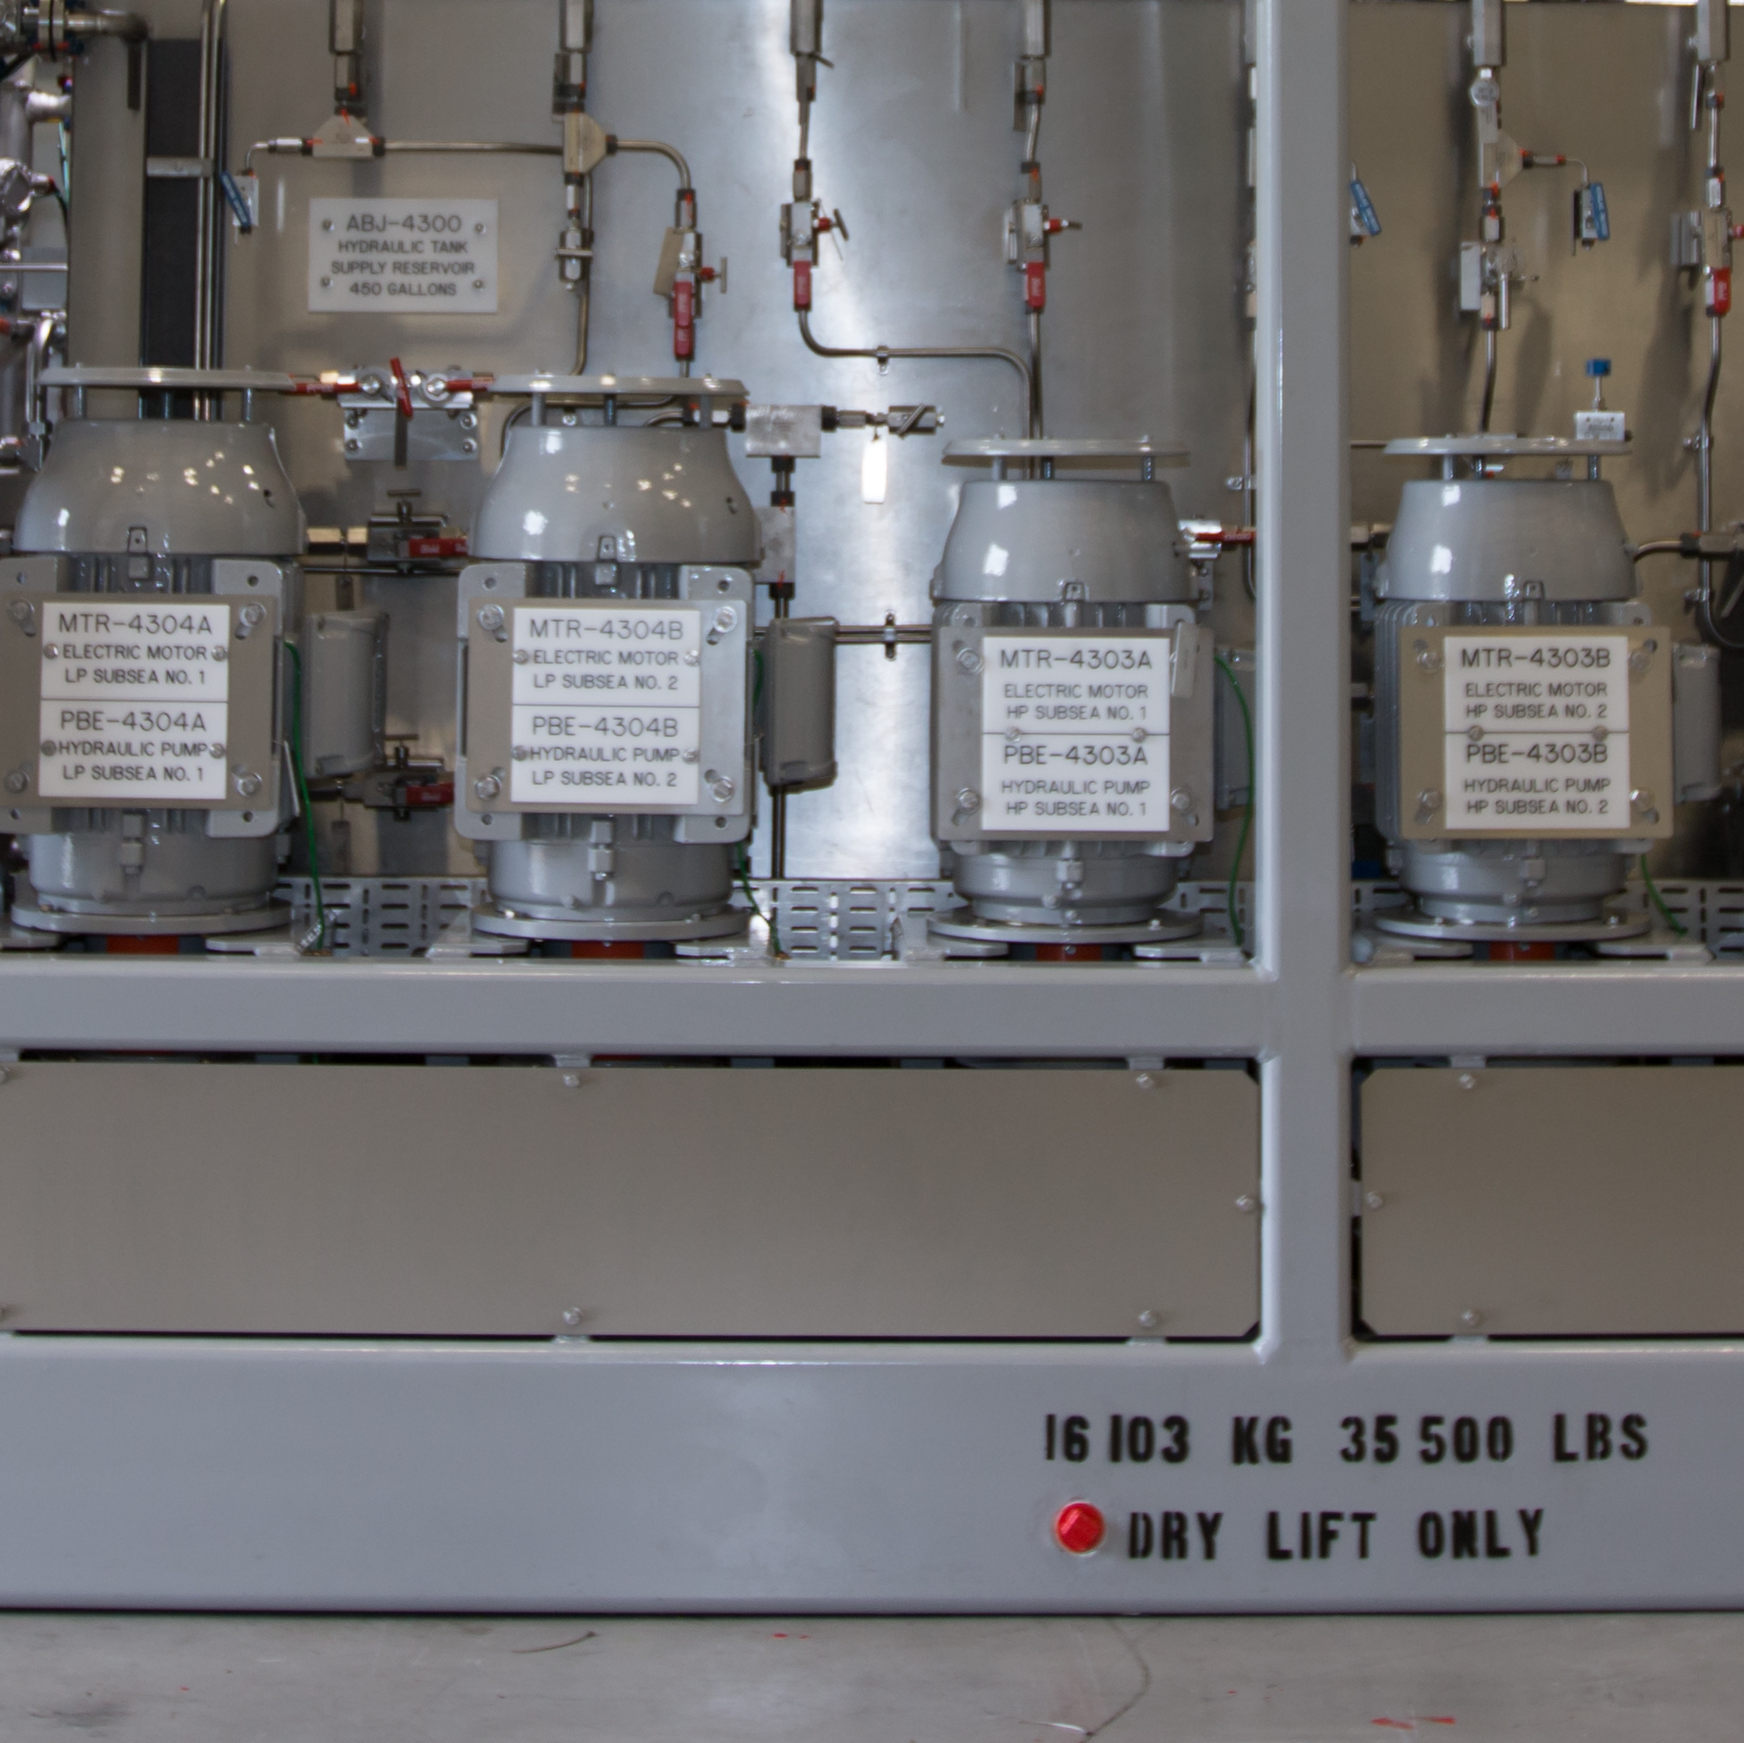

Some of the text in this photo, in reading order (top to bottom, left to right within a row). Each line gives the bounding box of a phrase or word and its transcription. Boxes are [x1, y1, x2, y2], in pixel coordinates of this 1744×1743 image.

[345, 213, 462, 234] ABJ-4300
[338, 239, 467, 254] HYDRAULIC TANK
[331, 260, 475, 275] SUPPLY RESERVOIR
[349, 281, 457, 296] 450 GALLONS
[58, 611, 212, 635] MTR-4304A
[529, 618, 684, 641] MTR-4304B
[62, 643, 207, 661] ELECTRIC MOTOR
[531, 649, 679, 666] ELECTRIC MOTOR
[1000, 648, 1152, 670] MTR-4303A
[1461, 647, 1611, 669] MTR-4303B
[64, 667, 205, 685] LP SUBSEA NO. 1
[533, 673, 678, 691] LP SUBSEA NO. 2
[1004, 683, 1148, 699] ELECTRIC MOTOR
[1465, 682, 1607, 698] ELECTRIC MOTOR
[1006, 704, 1147, 721] HP SUBSEA NO. 1
[1465, 703, 1608, 719] HP SUBSEA NO. 2
[59, 709, 206, 732] PBE-4304A
[532, 715, 678, 738] PBE-4304B
[58, 740, 208, 758] HYDRAULIC PUMP
[529, 745, 680, 763] HYDRAULIC PUMP
[1004, 744, 1148, 766] PBE-4303A
[1466, 742, 1608, 764] PBE-4303B
[62, 764, 203, 782] LP SUBSEA NO. 1
[532, 770, 677, 788] LP SUBSEA NO. 2
[1001, 779, 1151, 795] HYDRAULIC PUMP
[1463, 777, 1611, 794] HYDRAULIC PUMP
[1006, 800, 1147, 817] HP SUBSEA NO. 1
[1466, 799, 1609, 815] HP SUBSEA NO. 2
[1231, 1415, 1292, 1466] KG
[1553, 1412, 1648, 1463] LBS
[1127, 1508, 1544, 1562] DRY LIFT ONLY
